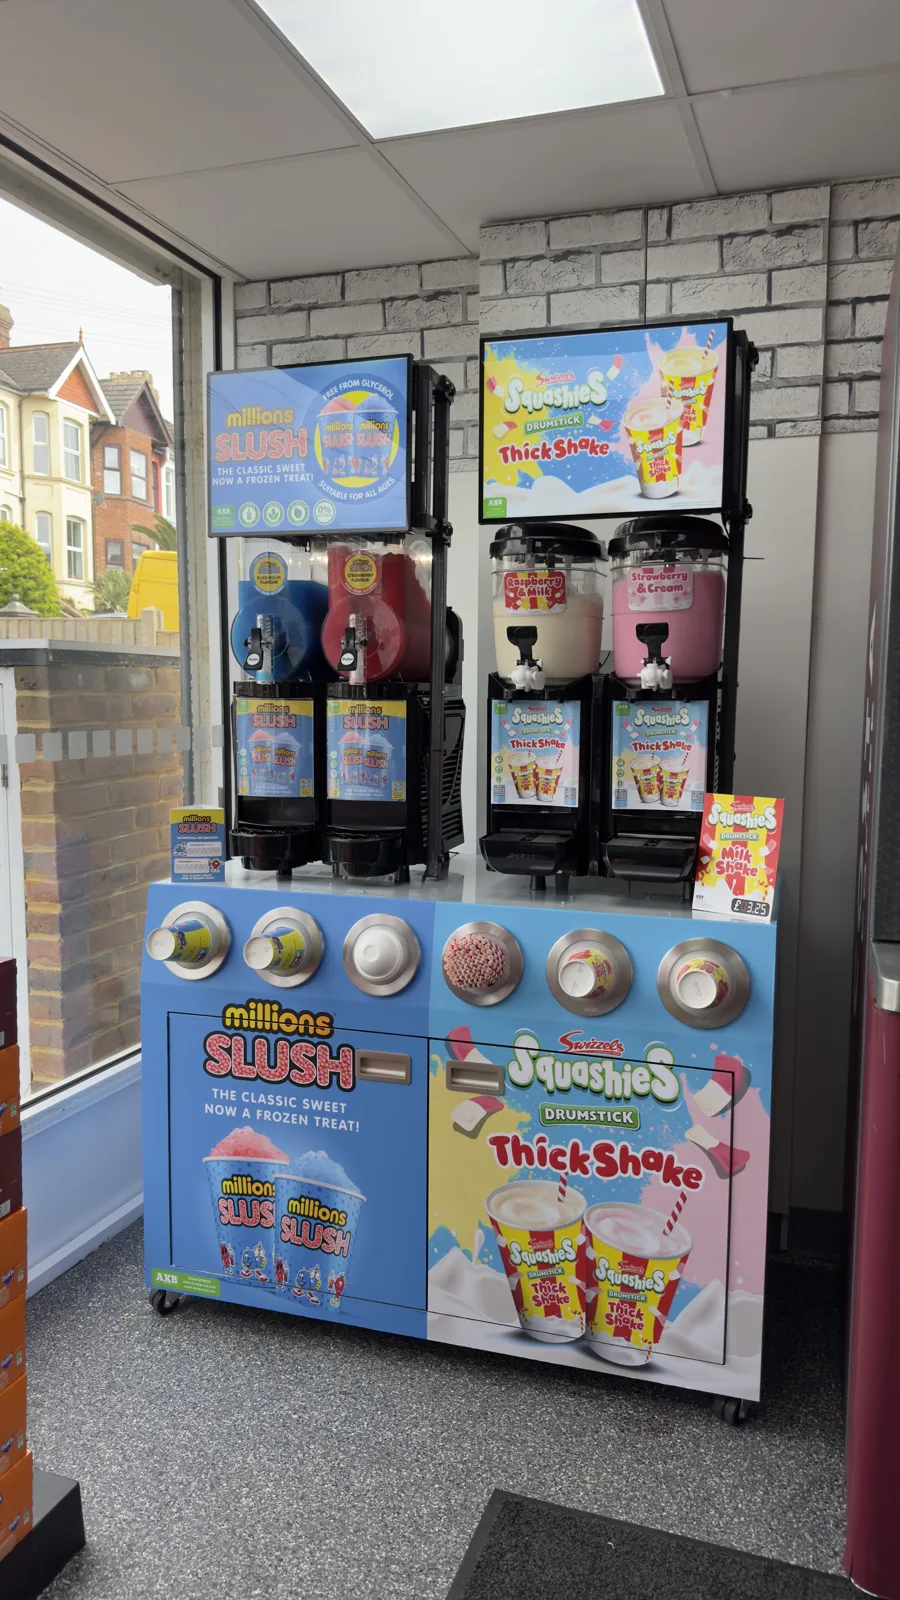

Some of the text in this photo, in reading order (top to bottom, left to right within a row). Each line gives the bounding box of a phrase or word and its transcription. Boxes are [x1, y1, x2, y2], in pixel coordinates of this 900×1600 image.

[322, 378, 394, 401] FREE FROM GLYCEROL
[226, 405, 295, 428] millions
[526, 415, 581, 432] DRUMSTICK
[214, 427, 308, 462] SLUSH
[217, 463, 306, 476] THE CLASSIC SWEET
[212, 472, 314, 486] NOW A FROZEN TREAT!
[318, 476, 395, 500] SUITABLE FOR ALL AGES
[317, 505, 332, 514] 0%
[507, 575, 563, 589] Raspberry
[631, 571, 688, 582] Strawberry
[517, 586, 552, 598] & Milk
[636, 582, 684, 594] & Cream
[257, 703, 290, 713] millions
[349, 704, 382, 715] millions
[252, 714, 297, 728] SLUSH
[343, 715, 389, 730] SLUSH
[183, 814, 211, 822] millions
[178, 822, 217, 833] SLUSH
[721, 845, 753, 865] Milk
[715, 860, 758, 877] Shake
[224, 1000, 332, 1037] millions
[559, 1030, 625, 1056] Swizzels
[205, 1032, 354, 1091] SLUSH
[212, 1088, 347, 1114] THE CLASSIC SWEET
[204, 1103, 360, 1132] NOW A FROZEN TREAT!
[544, 1107, 634, 1124] DRUMSTICK
[218, 1197, 275, 1228] SLUS
[288, 1196, 347, 1228] millions
[280, 1215, 351, 1257] SLUSH
[156, 1272, 178, 1284] AXB
[528, 1268, 563, 1278] DRUMSTICK
[530, 1281, 567, 1295] Thick
[608, 1290, 646, 1301] DRUMSTICK
[531, 1293, 570, 1308] Shake
[607, 1302, 644, 1321] Thick
[604, 1312, 645, 1331] Shake
